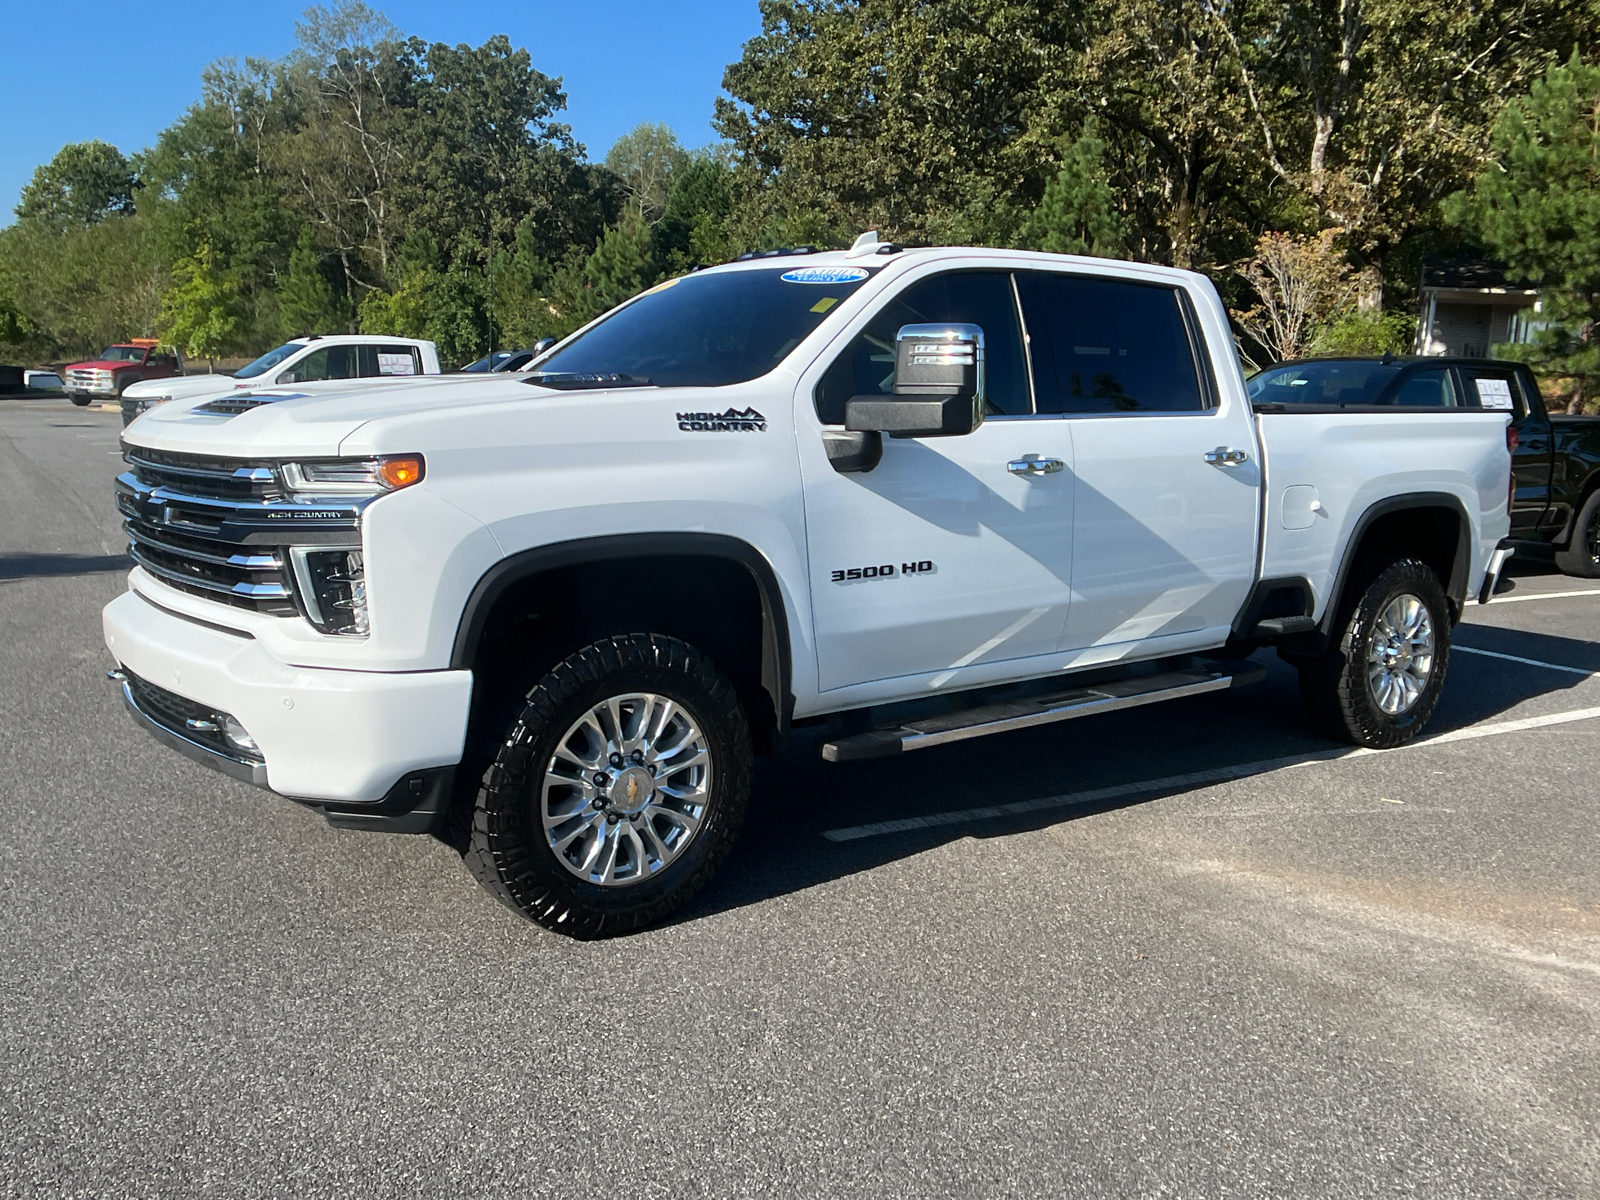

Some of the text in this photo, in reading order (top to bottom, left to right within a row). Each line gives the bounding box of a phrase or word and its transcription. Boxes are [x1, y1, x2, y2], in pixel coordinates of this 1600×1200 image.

[675, 412, 722, 421] HIGH
[678, 421, 767, 432] COUNTRY
[831, 561, 932, 582] 3500 HD
